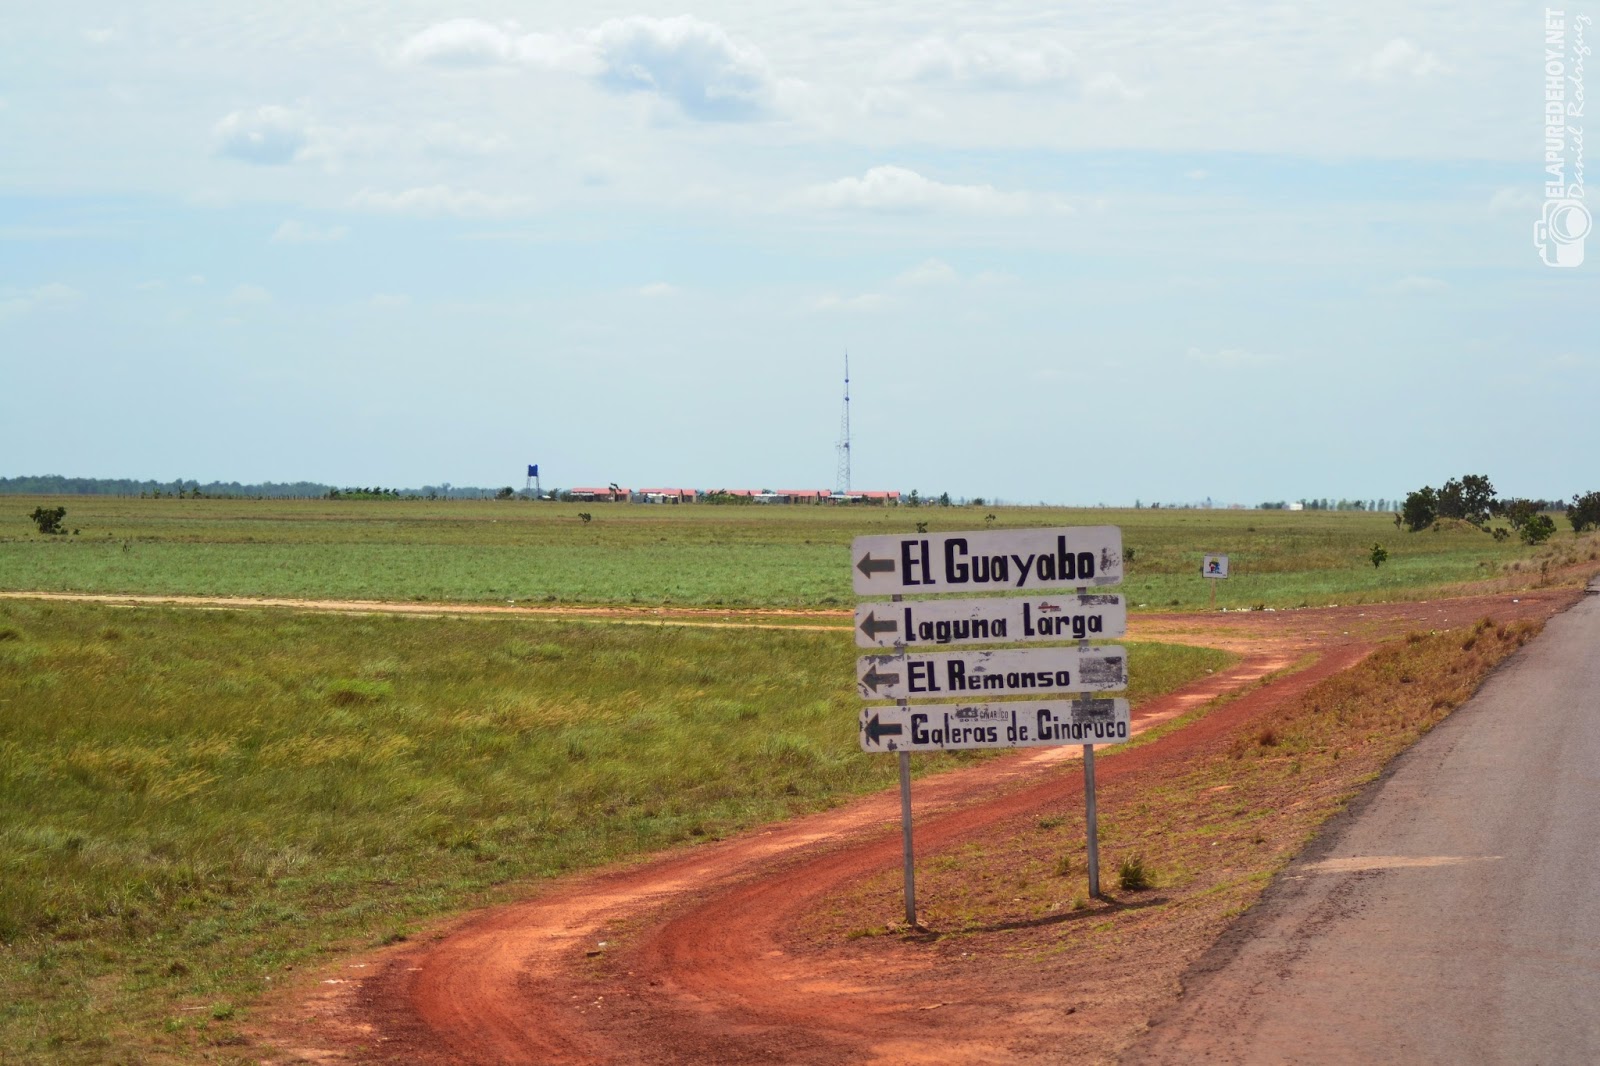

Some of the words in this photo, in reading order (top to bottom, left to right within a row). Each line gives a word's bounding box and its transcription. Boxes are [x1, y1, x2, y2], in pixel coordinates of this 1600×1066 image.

[944, 535, 1094, 587] Guayabo
[904, 607, 1007, 643] Laguna
[1023, 602, 1102, 638] Larga
[947, 660, 1069, 690] Remanso
[911, 713, 997, 744] Galeras
[1007, 711, 1028, 742] de
[1037, 709, 1126, 740] Cinaruco
[980, 710, 1009, 720] CINARCO
